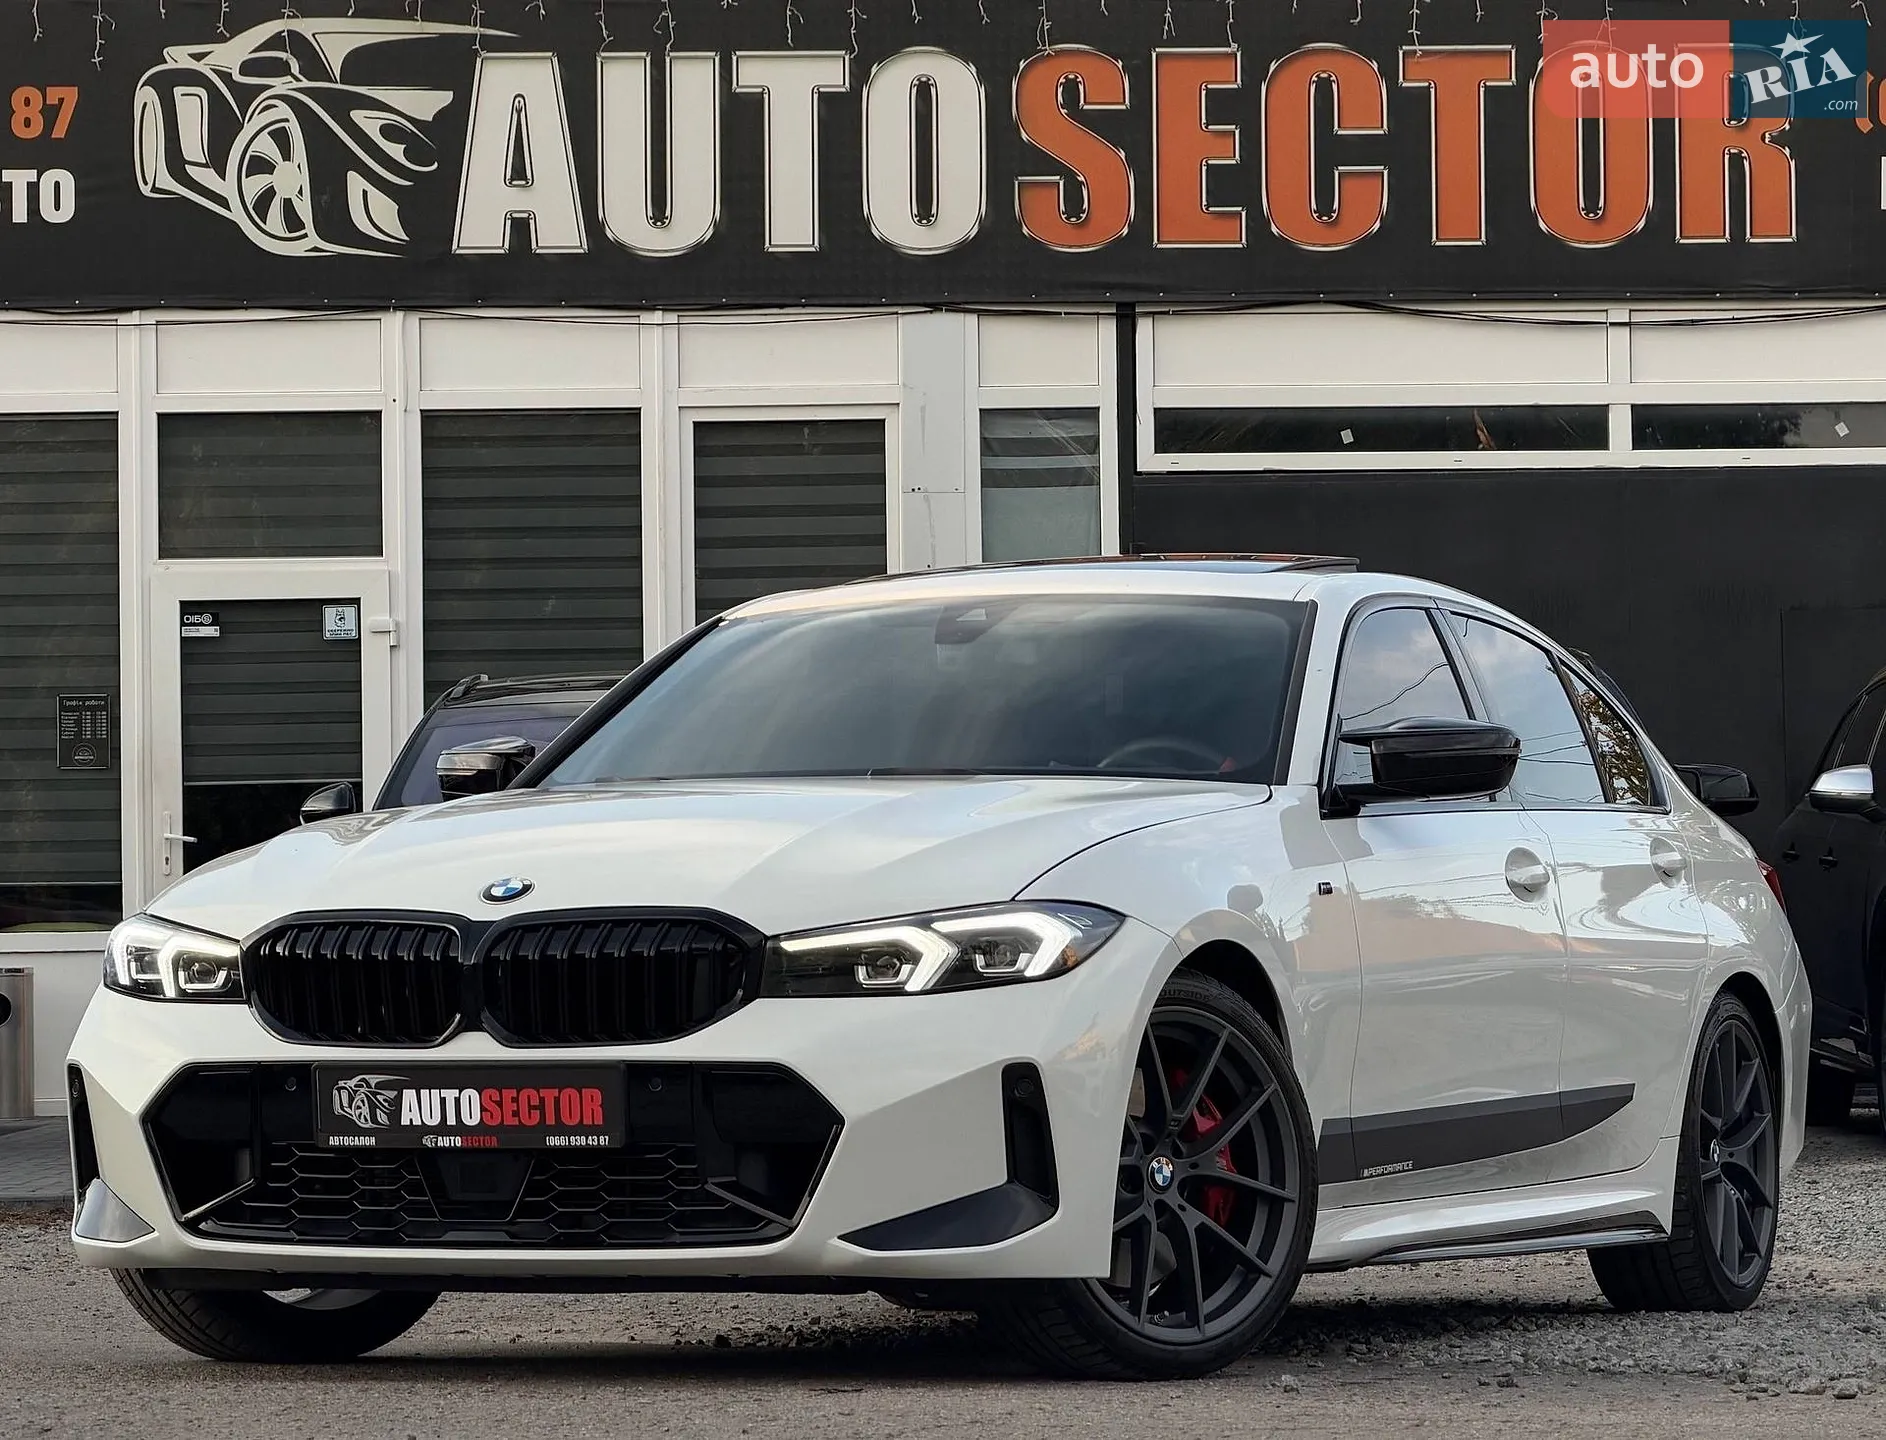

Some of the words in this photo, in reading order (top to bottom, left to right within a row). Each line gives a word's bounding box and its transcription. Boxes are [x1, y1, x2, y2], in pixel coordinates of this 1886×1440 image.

[10, 85, 79, 139] 87
[452, 44, 1798, 256] AUTOSECTOR
[400, 1087, 604, 1127] AUTOSECTOR
[437, 1135, 498, 1147] AUTOSECTOR
[546, 1135, 569, 1146] (066)
[569, 1135, 586, 1146] 930
[587, 1135, 598, 1146] 43
[599, 1135, 609, 1146] 87
